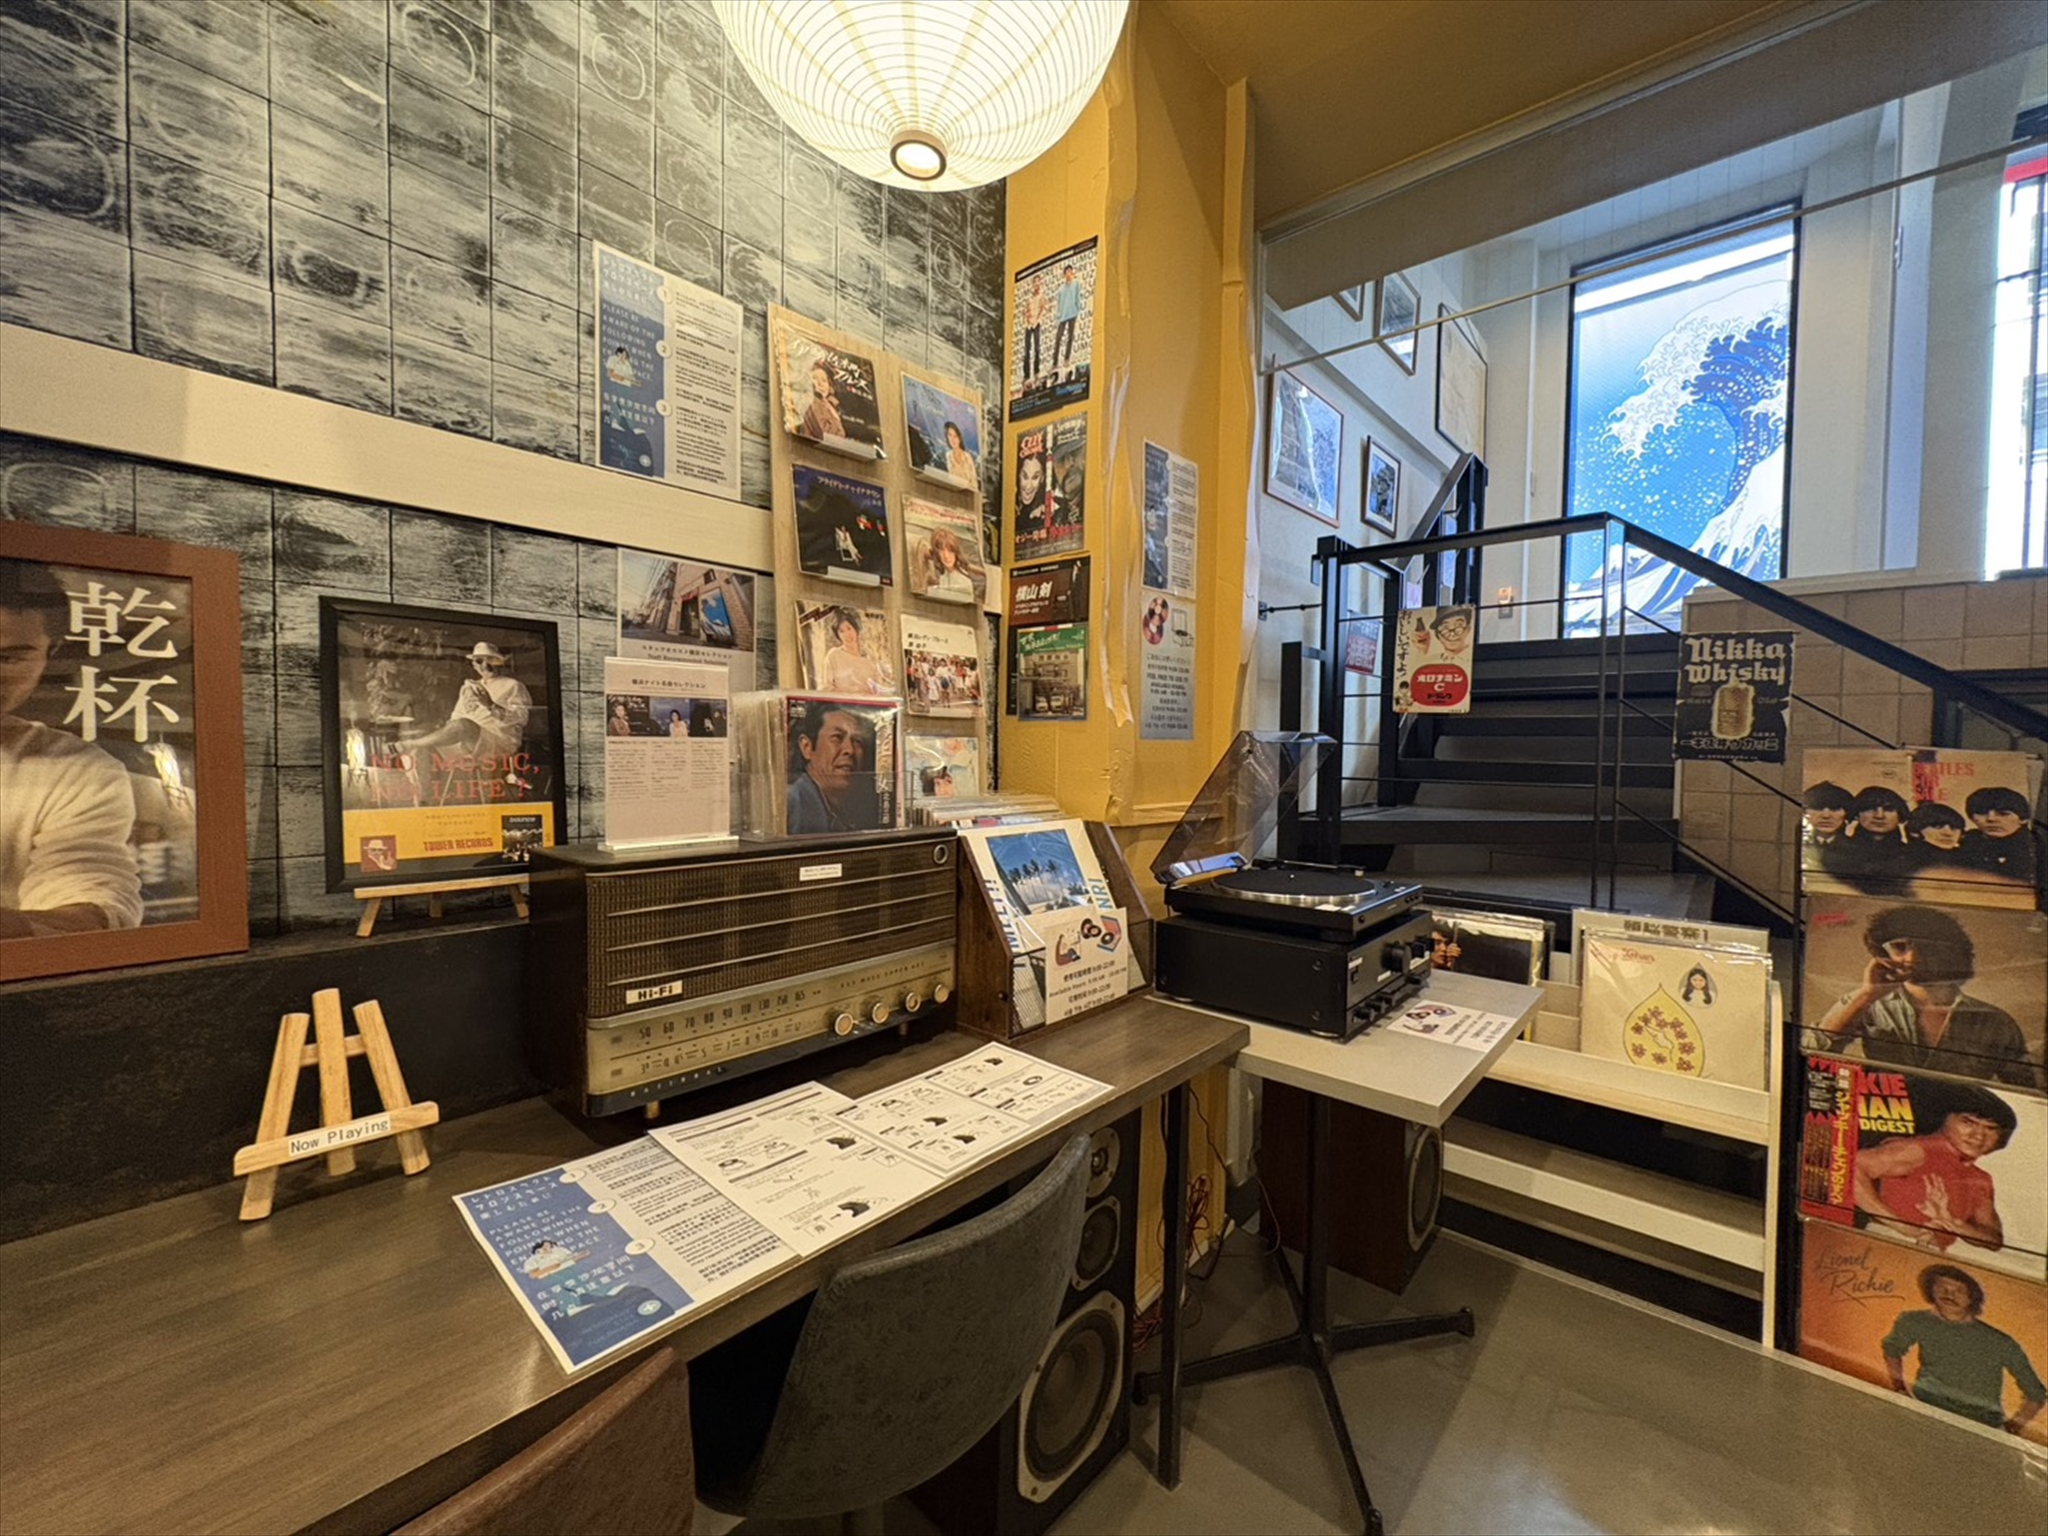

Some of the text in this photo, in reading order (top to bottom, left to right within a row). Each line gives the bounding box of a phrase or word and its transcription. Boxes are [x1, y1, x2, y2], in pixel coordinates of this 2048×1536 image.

[1684, 637, 1786, 663] Nikka
[63, 580, 181, 744] 乾杯
[1417, 673, 1464, 683] オロナミン
[1433, 682, 1446, 692] C
[430, 752, 541, 775] MUSIC,
[423, 837, 494, 852] TOWER RECORDS
[290, 1118, 389, 1154] Now Playing
[1858, 1119, 1915, 1135] DIGEST
[488, 1216, 533, 1236] PLEASE
[495, 1204, 582, 1242] AWARE OF THE
[499, 1217, 574, 1249] FOLLOWING
[553, 1219, 591, 1237] WHEN
[577, 1226, 601, 1239] THE
